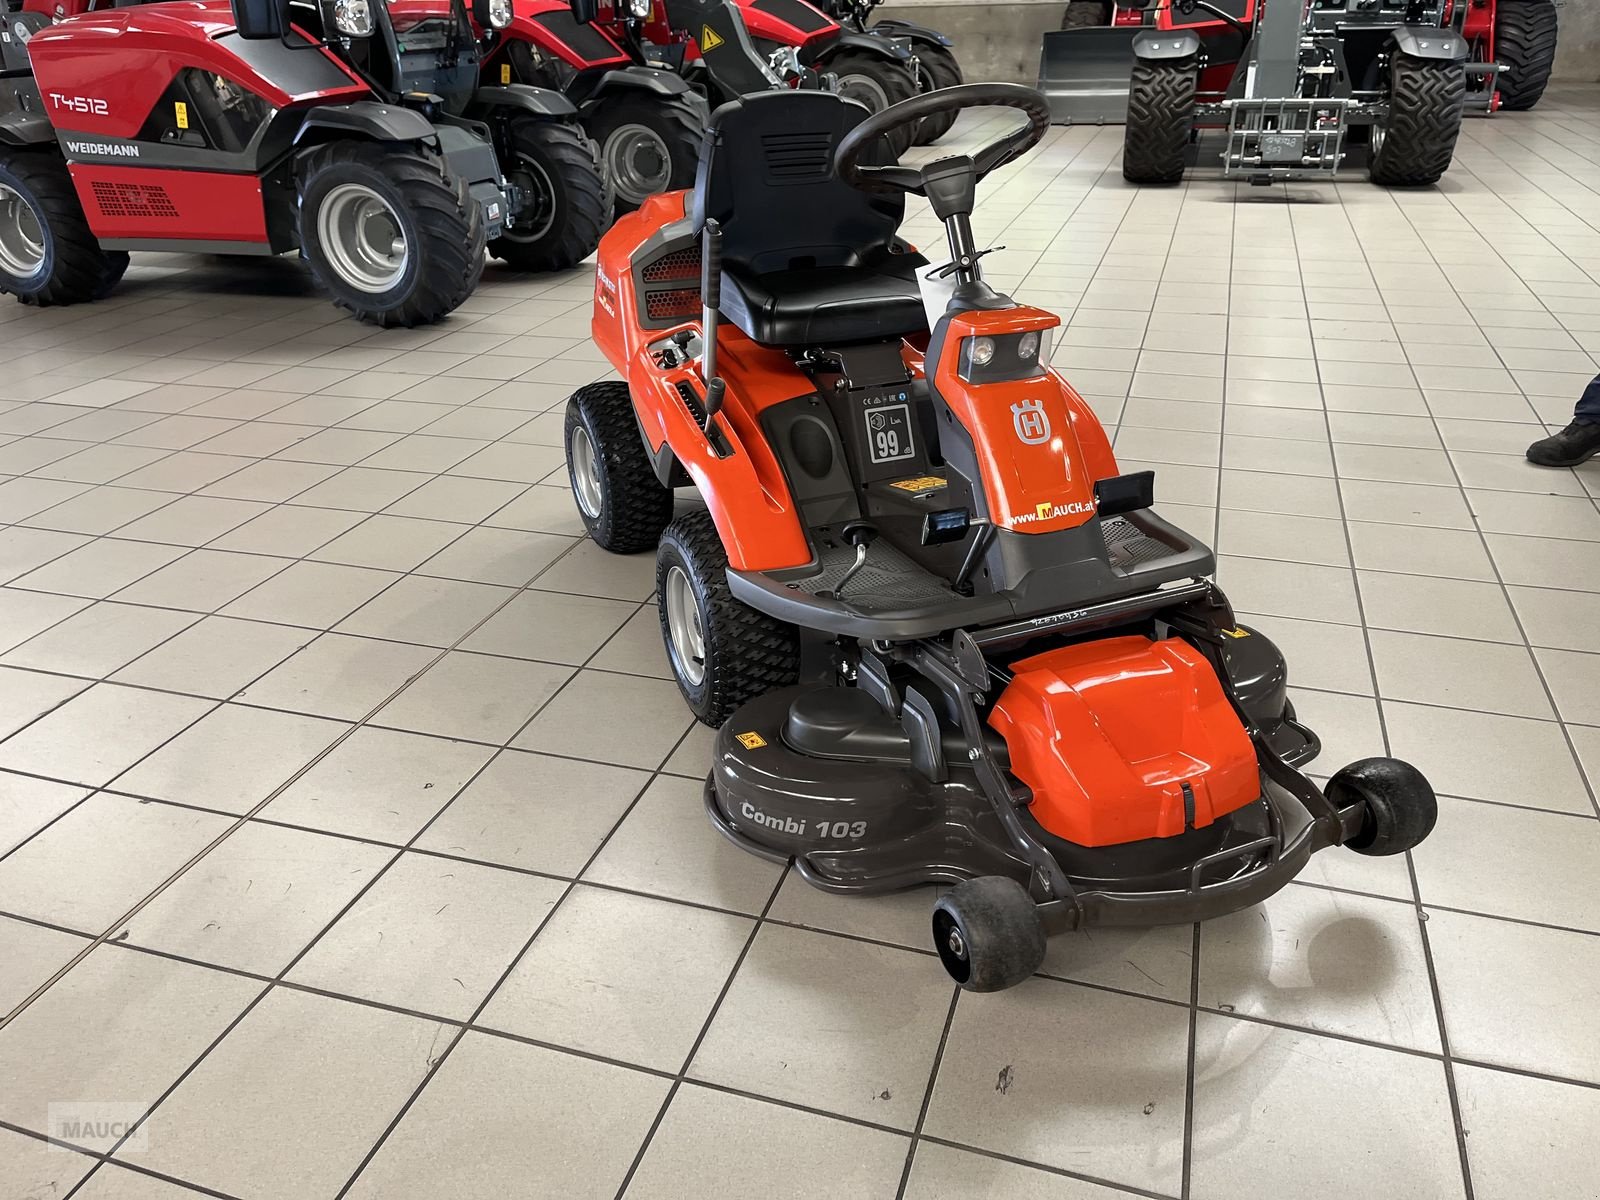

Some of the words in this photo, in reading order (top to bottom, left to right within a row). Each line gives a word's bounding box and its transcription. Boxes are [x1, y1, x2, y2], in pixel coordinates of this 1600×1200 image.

[49, 93, 109, 115] T4512
[66, 141, 140, 157] WEIDEMANN
[876, 430, 899, 457] 99
[1007, 501, 1094, 525] www.MAUCH.at
[741, 801, 806, 835] Combi
[816, 821, 867, 838] 103
